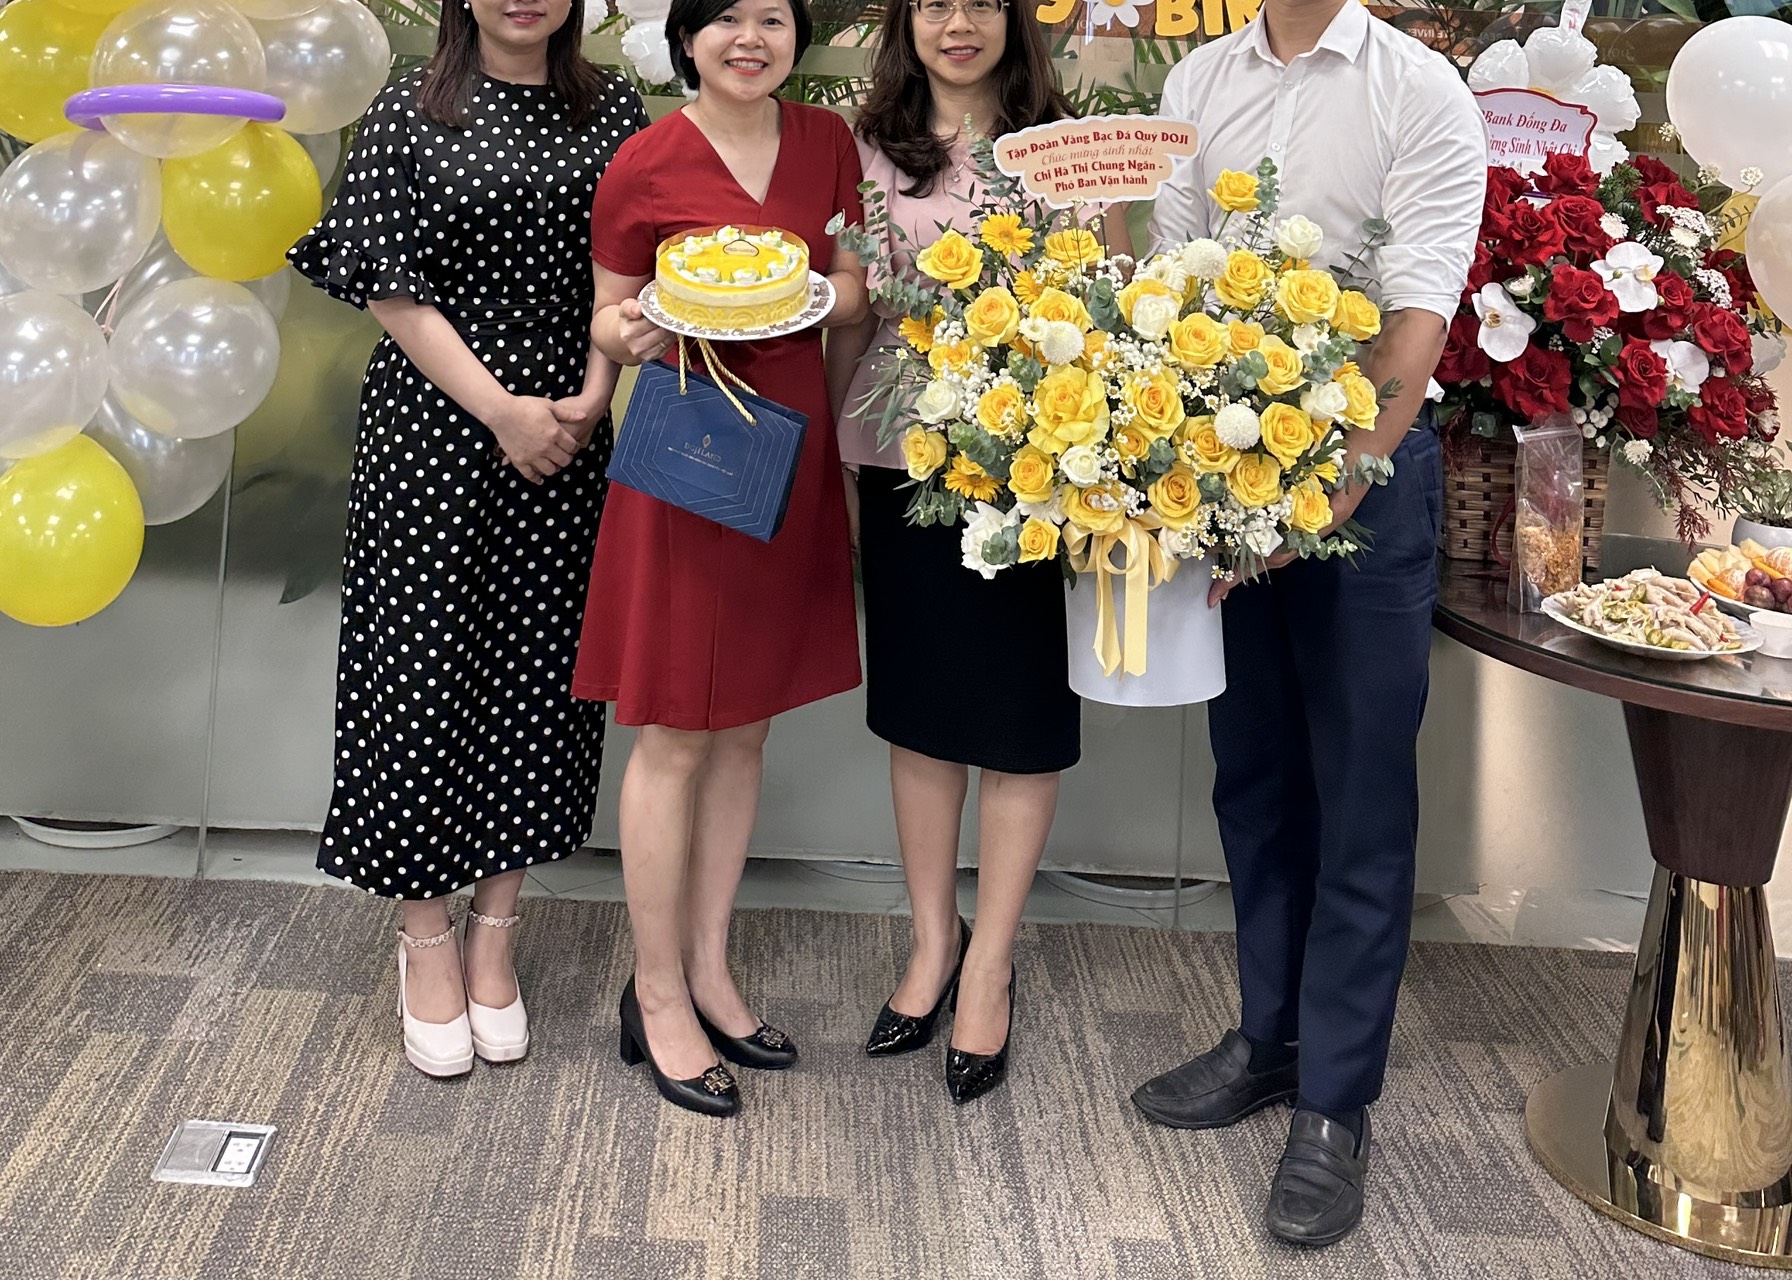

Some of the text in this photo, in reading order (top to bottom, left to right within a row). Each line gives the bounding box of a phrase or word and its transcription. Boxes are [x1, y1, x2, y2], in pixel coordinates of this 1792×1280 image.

[1516, 112, 1548, 133] Đống
[1549, 118, 1568, 133] Đa
[1006, 130, 1189, 160] Tập Đoàn Vàng Bạc Đá Quý DOJI
[1041, 143, 1154, 166] Chúc mừng sinh nhật
[1509, 137, 1532, 155] Sinh
[1034, 169, 1052, 182] Chị
[1053, 166, 1069, 178] Hà
[1071, 162, 1089, 174] Thị
[1091, 161, 1125, 172] Chung
[1127, 159, 1156, 172] Ngân
[1055, 174, 1148, 193] Phó Ban Vận hành
